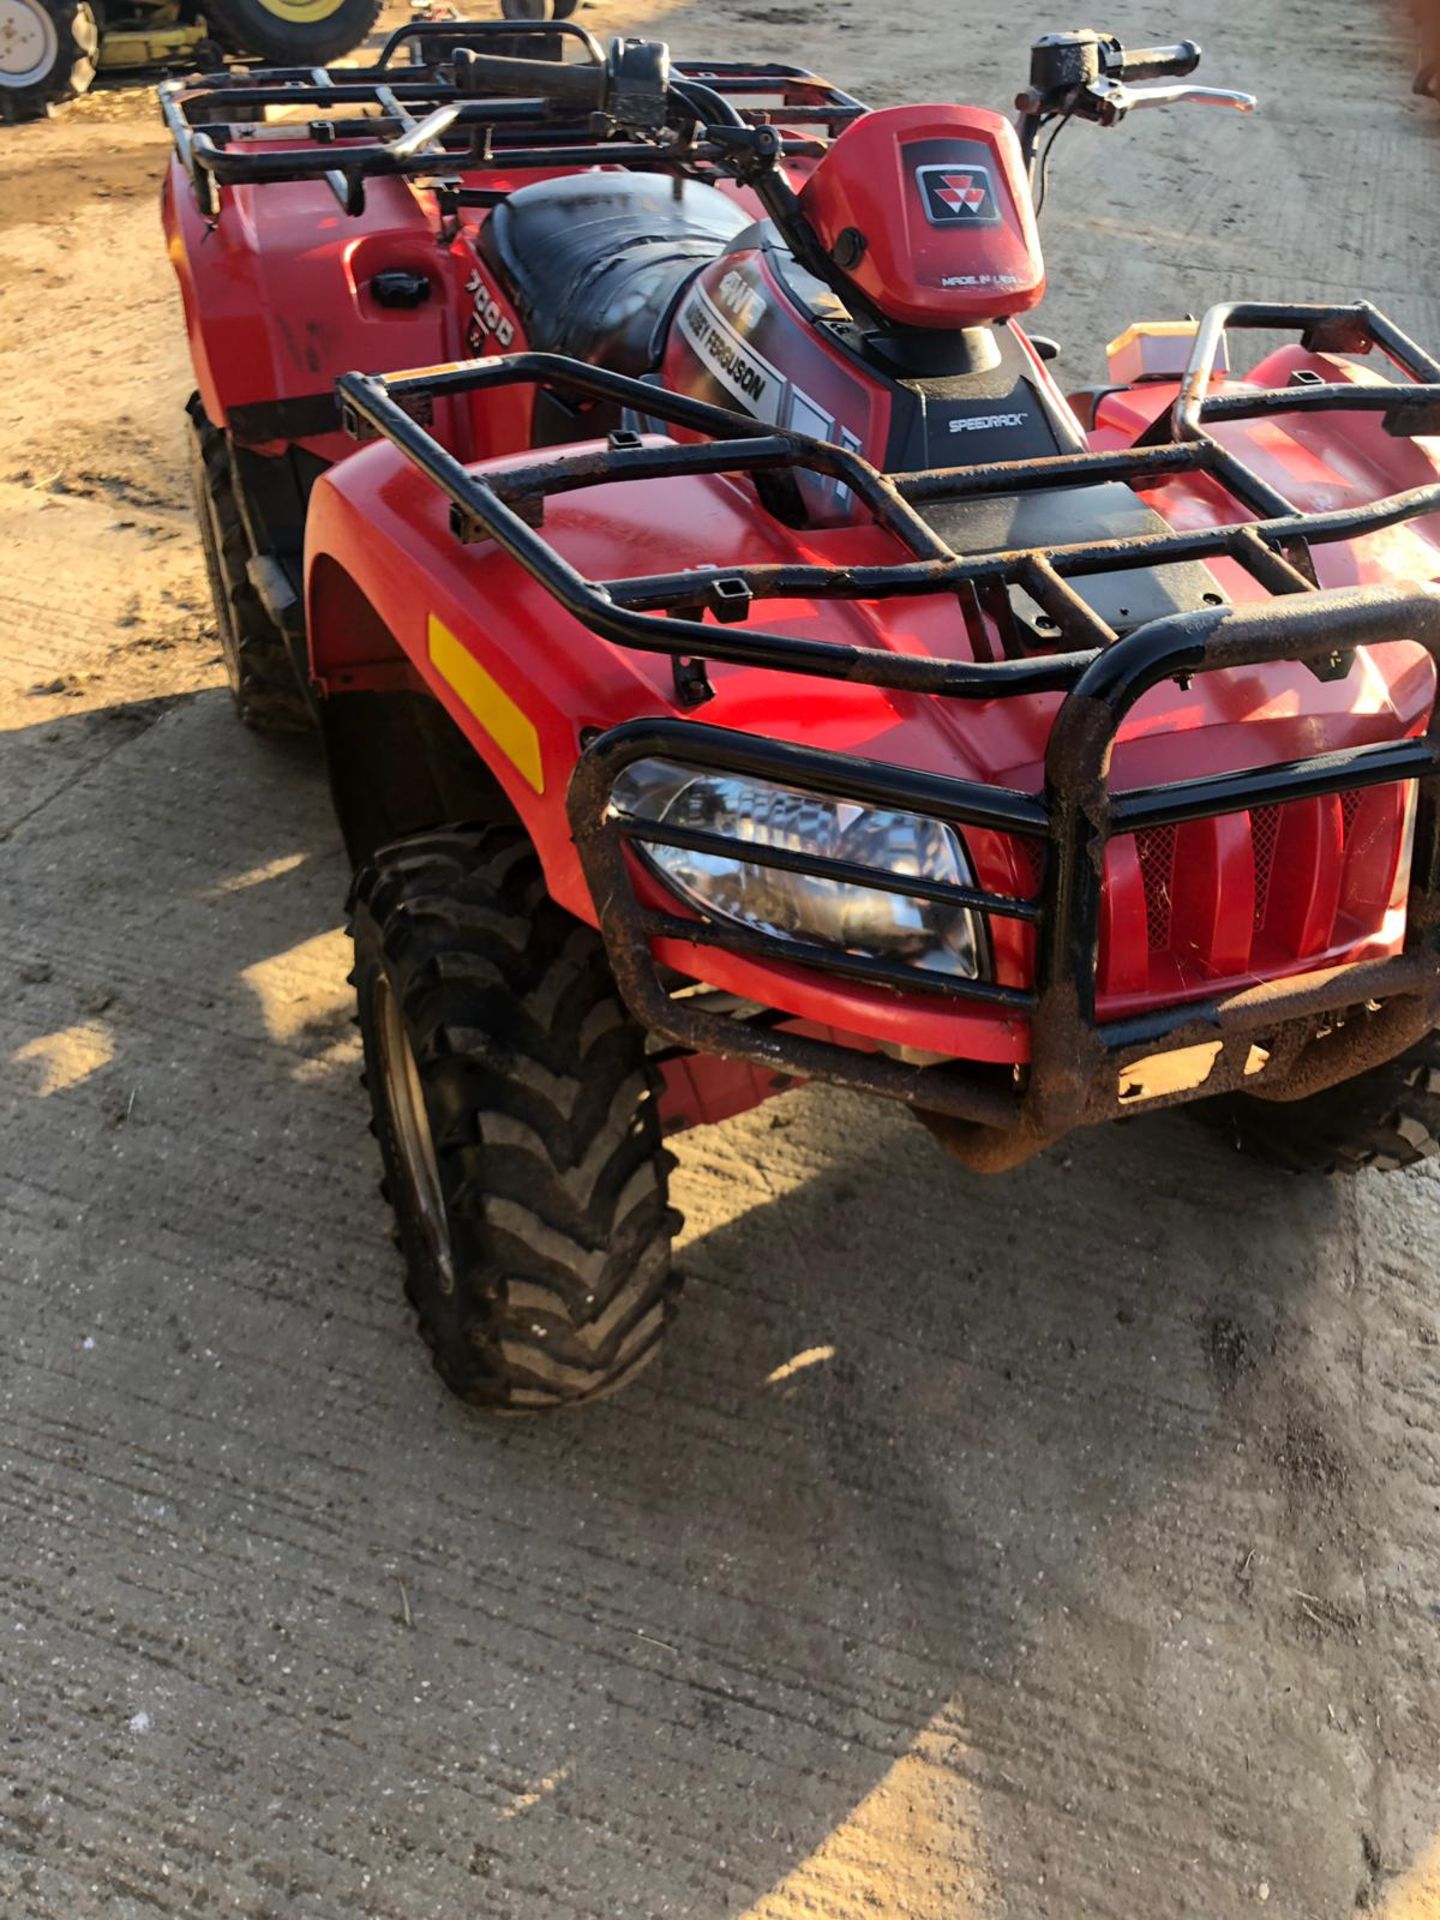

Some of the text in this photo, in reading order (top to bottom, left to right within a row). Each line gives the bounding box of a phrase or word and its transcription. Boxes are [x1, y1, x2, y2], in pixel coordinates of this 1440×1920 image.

[942, 276, 976, 287] MADE
[979, 275, 991, 285] IN
[704, 329, 766, 402] FERGUSON
[949, 413, 1023, 432] SPEEDRACK
